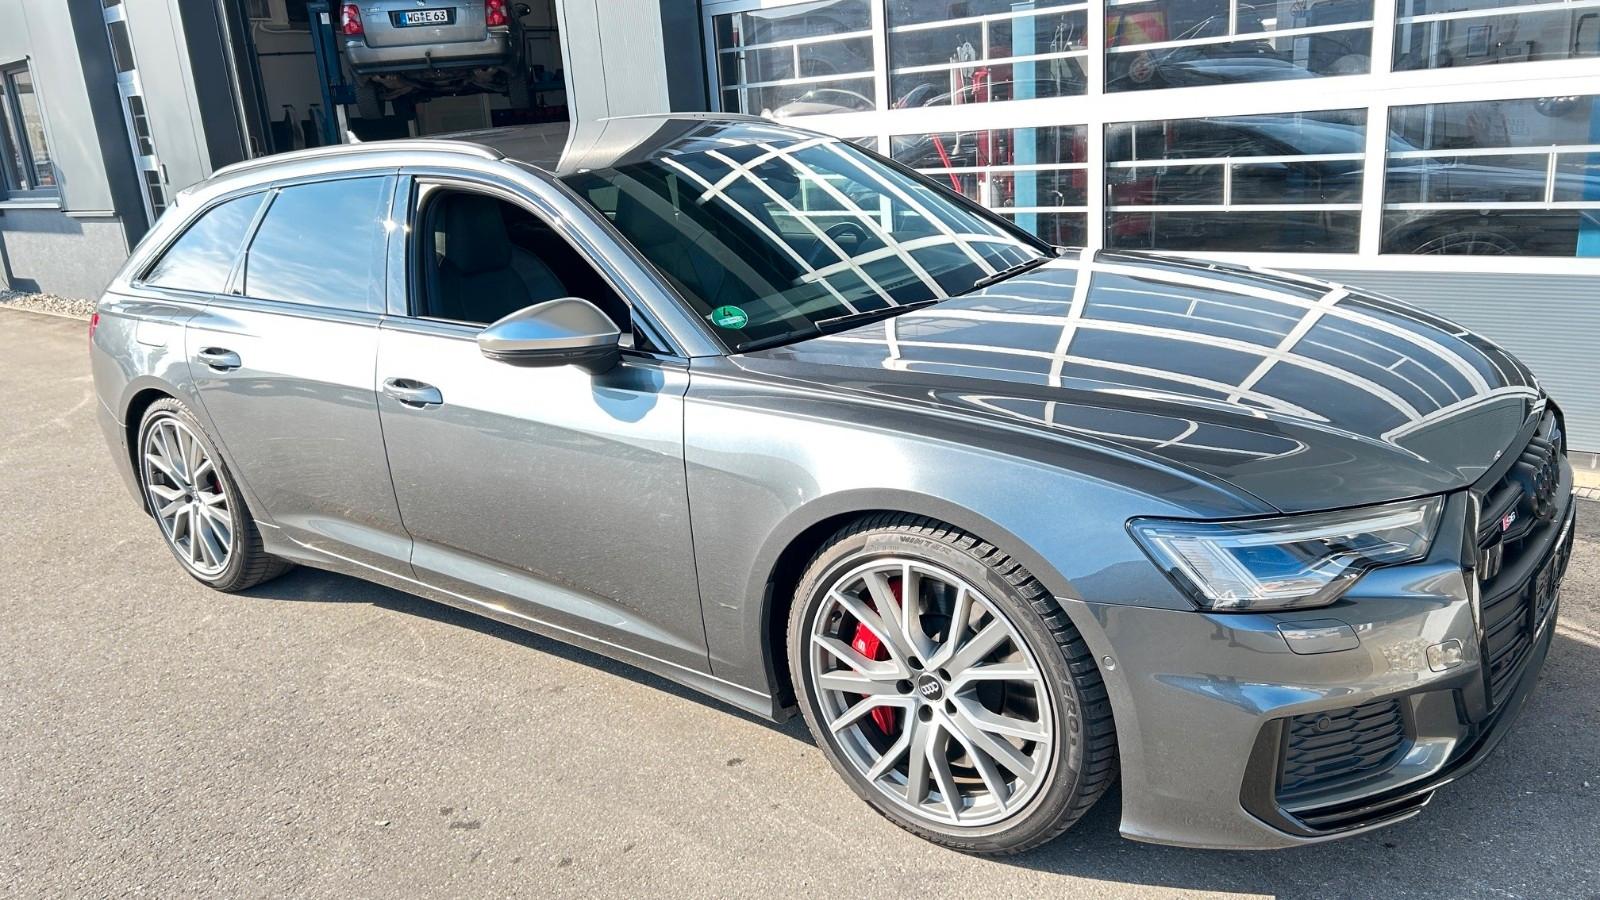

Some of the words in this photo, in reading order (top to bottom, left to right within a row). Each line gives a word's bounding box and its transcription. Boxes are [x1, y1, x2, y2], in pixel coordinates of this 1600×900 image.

[407, 12, 420, 22] WG
[433, 11, 446, 21] 63
[899, 535, 953, 556] WINTER
